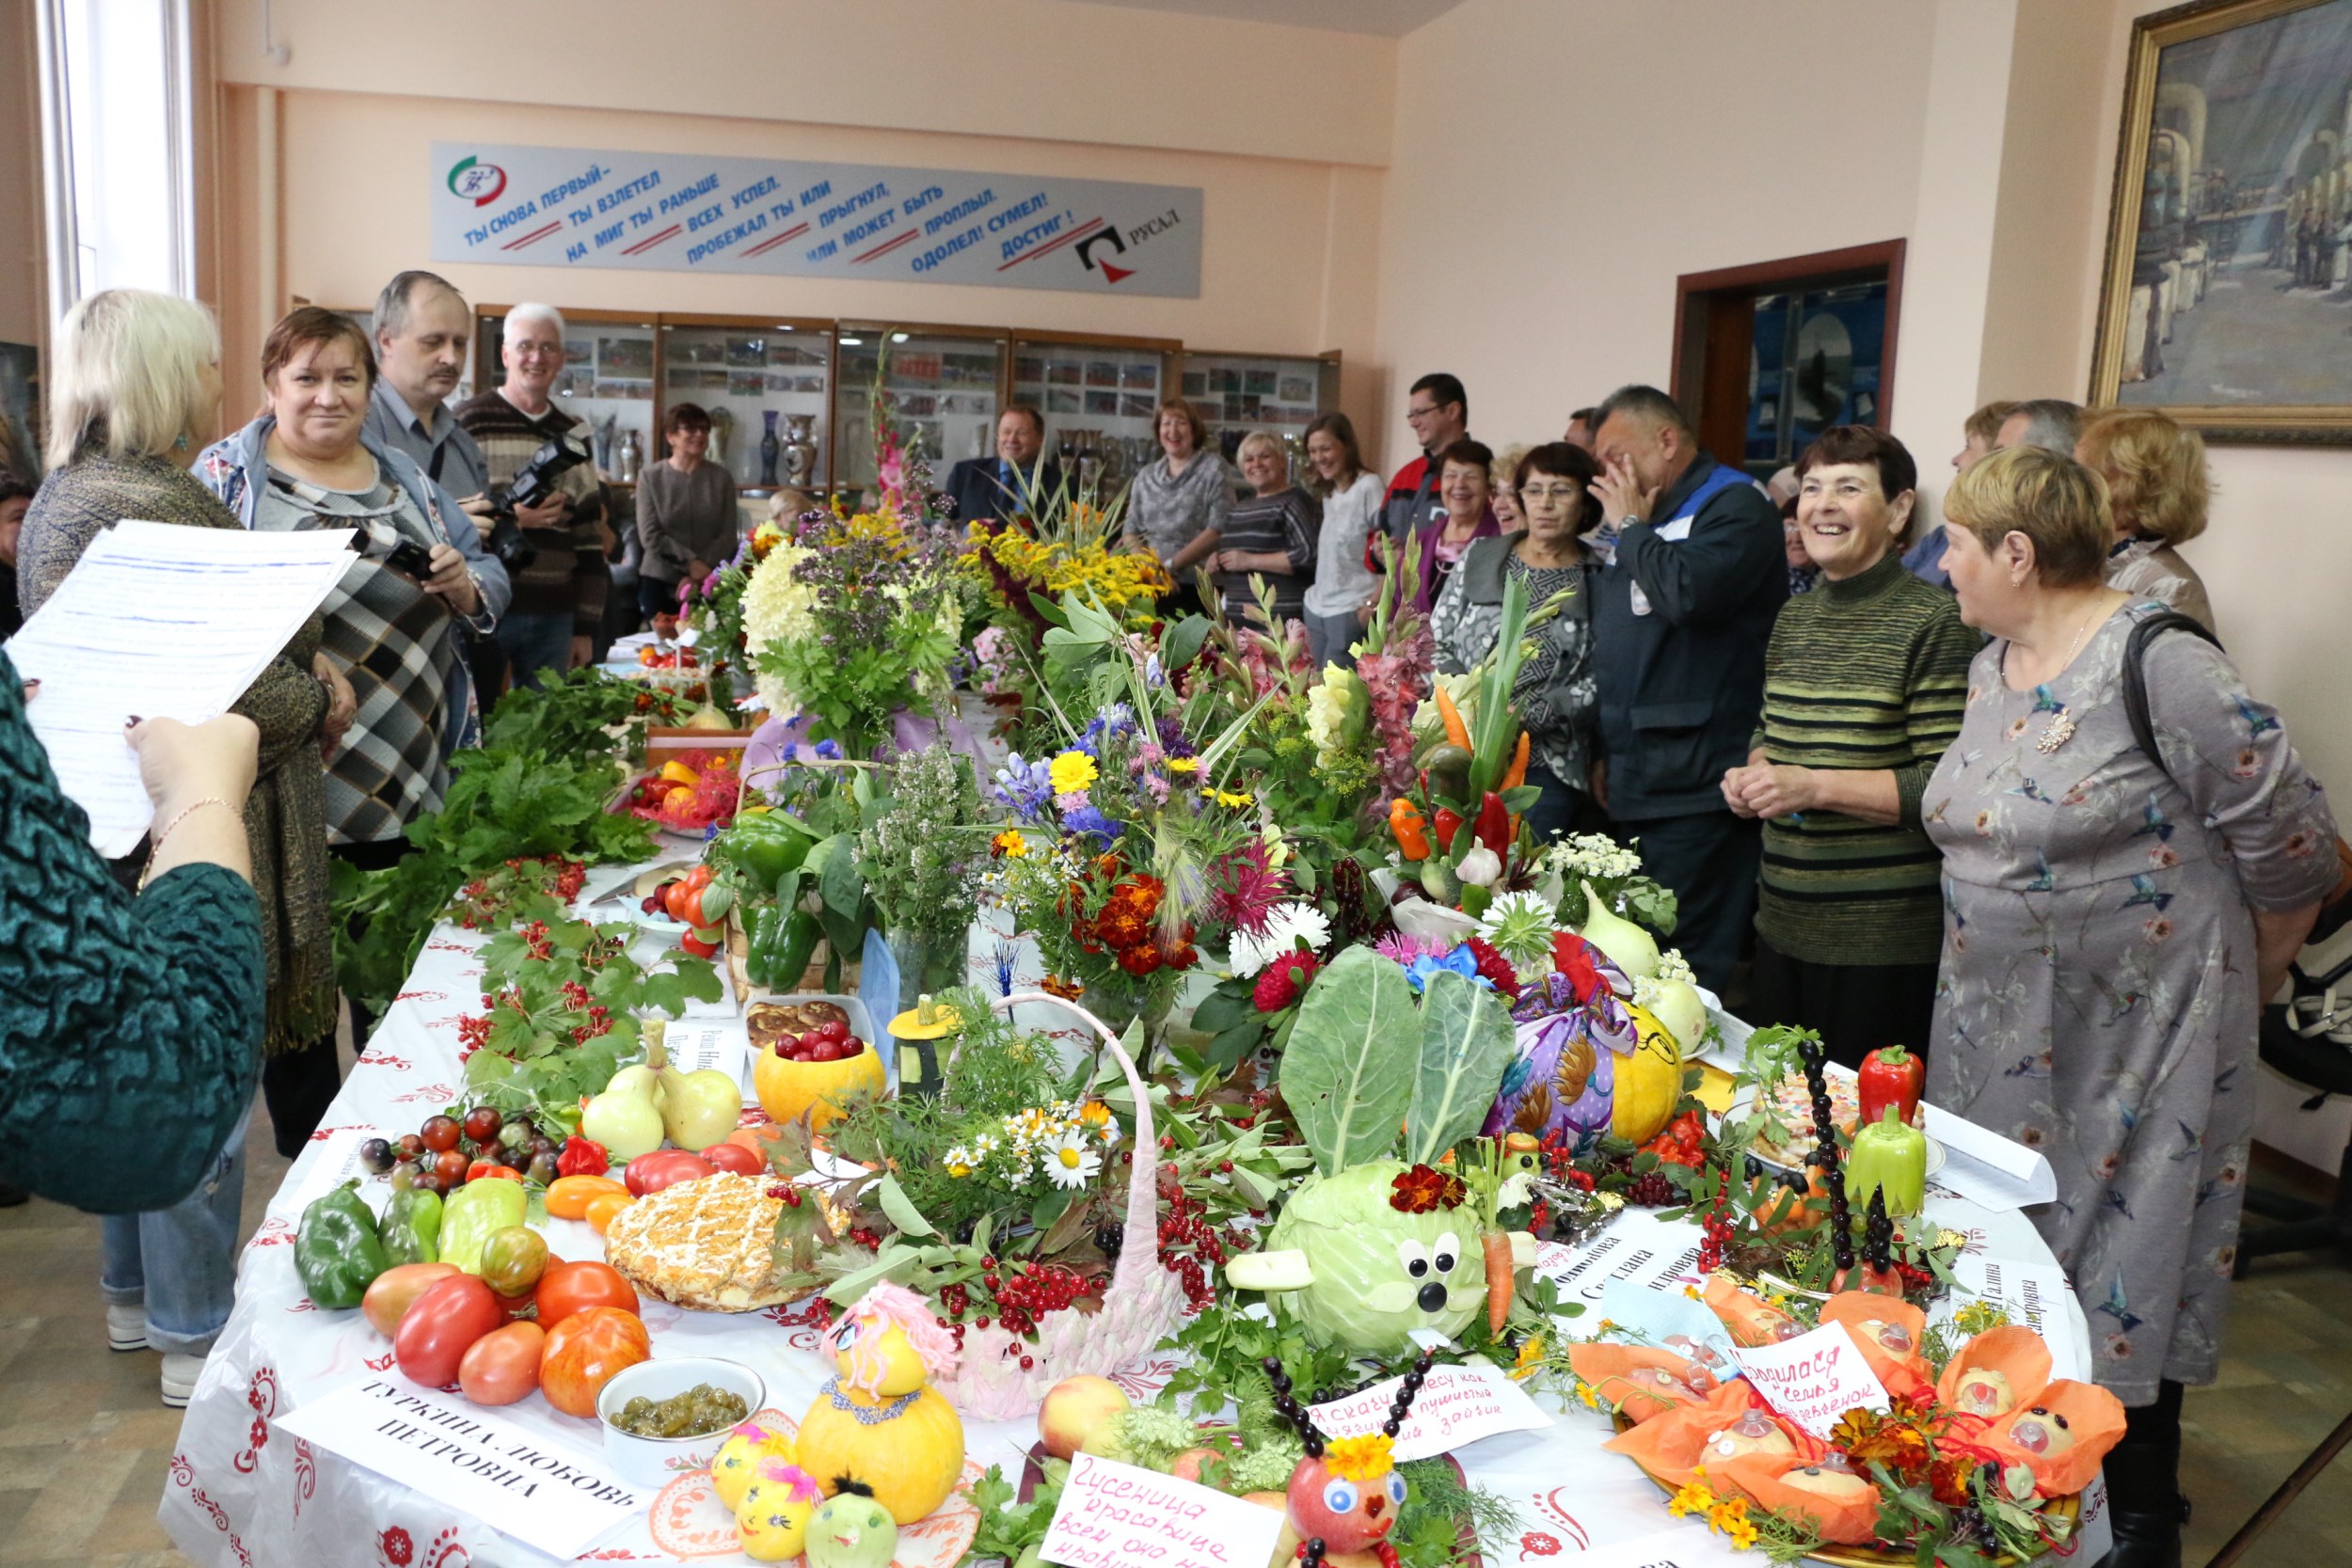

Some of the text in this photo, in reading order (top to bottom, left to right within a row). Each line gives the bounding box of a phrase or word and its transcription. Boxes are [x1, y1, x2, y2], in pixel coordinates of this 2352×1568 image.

[464, 227, 488, 247] ТЫ
[489, 202, 538, 238] СНОВА
[566, 173, 721, 263] НА МИГ ТЫ РАНЬШЕ
[567, 170, 661, 228] ТЫ ВЗЛЕТЕЛ
[685, 180, 833, 264] ПРОБЕЖАЛ ТЫ ИЛИ
[687, 204, 724, 233] ВСЕХ
[843, 209, 897, 246] МОЖЕТ
[903, 186, 945, 216] БЫТЬ
[1128, 209, 1182, 245] РУСАЛ
[912, 193, 1050, 274] ОДОЛЕЛ! СУМЕЛ!
[1555, 1237, 1622, 1291] одионова
[1981, 1263, 2003, 1301] Галина
[361, 1380, 635, 1507] ТУРКИНА ЛЮБОВЬ
[1310, 1407, 1327, 1424] Я
[374, 1418, 542, 1499] ПЕТРОВНА
[1122, 1539, 1168, 1559] она
